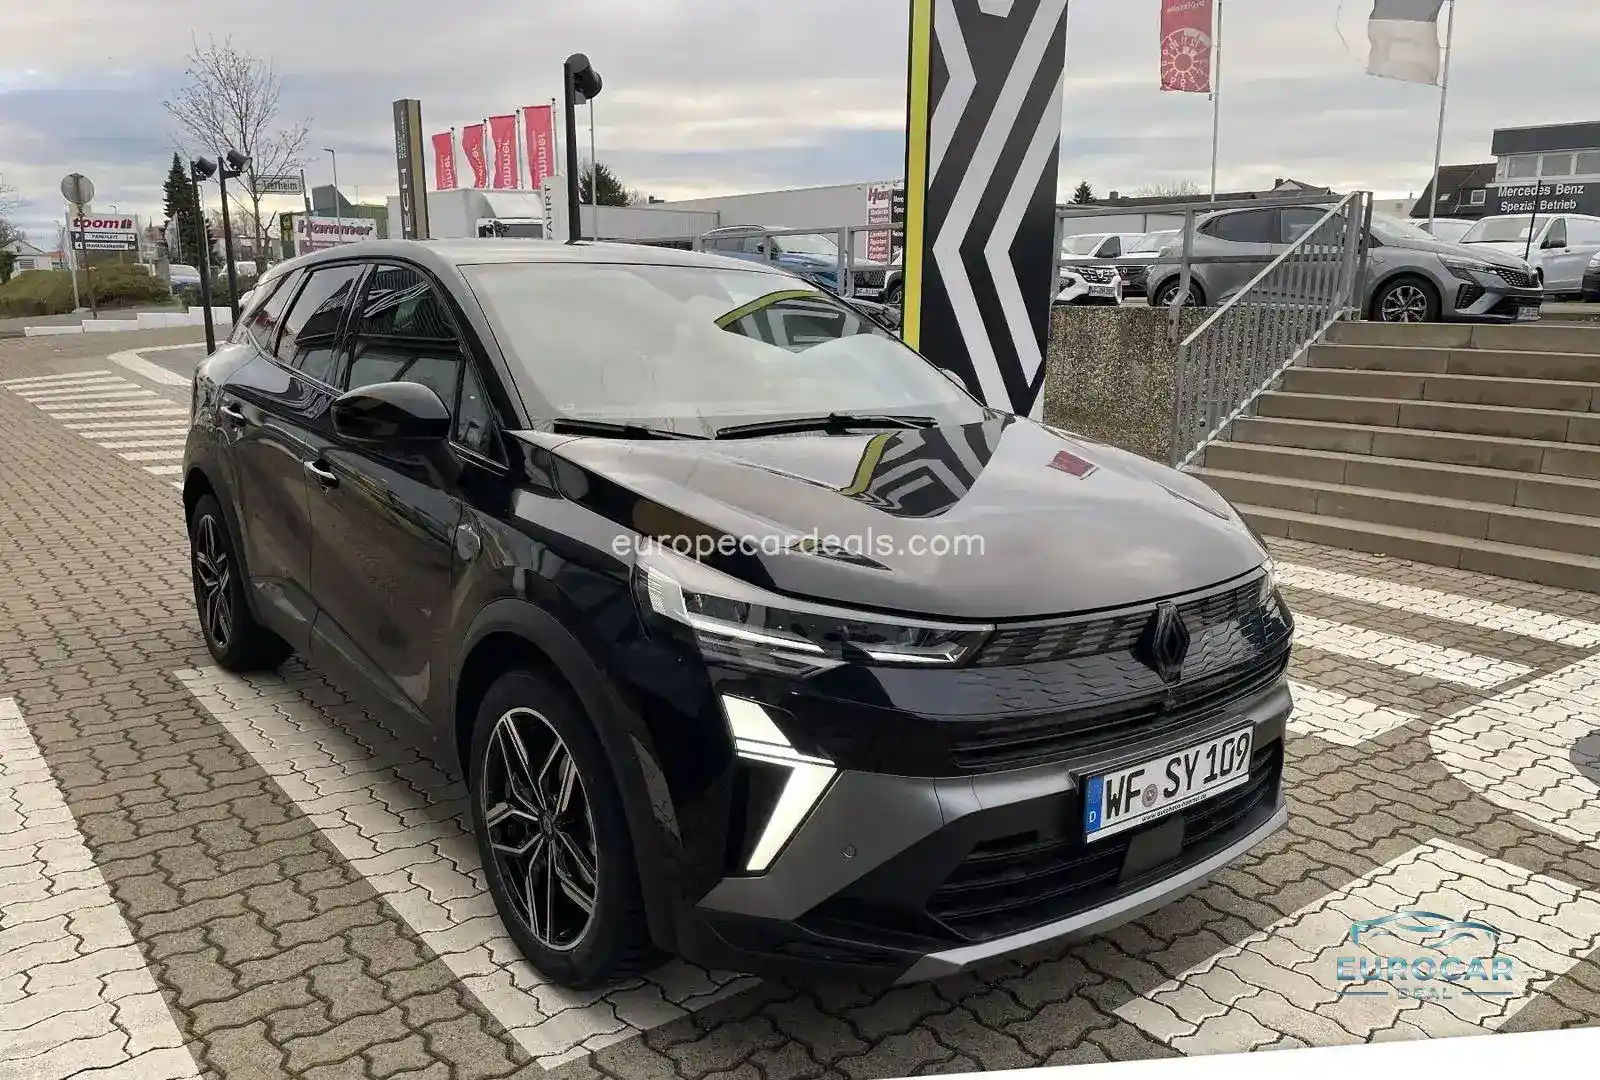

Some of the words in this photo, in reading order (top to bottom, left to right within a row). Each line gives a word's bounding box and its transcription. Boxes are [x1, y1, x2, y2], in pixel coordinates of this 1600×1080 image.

[1498, 185, 1551, 197] Mercedes
[1556, 184, 1584, 195] Benz
[1540, 199, 1577, 210] Betrieb
[73, 218, 119, 229] toom
[298, 220, 373, 240] Hammer
[1106, 768, 1145, 820] WF
[1163, 750, 1201, 798] SY
[1203, 732, 1251, 784] 109
[1088, 811, 1096, 823] D
